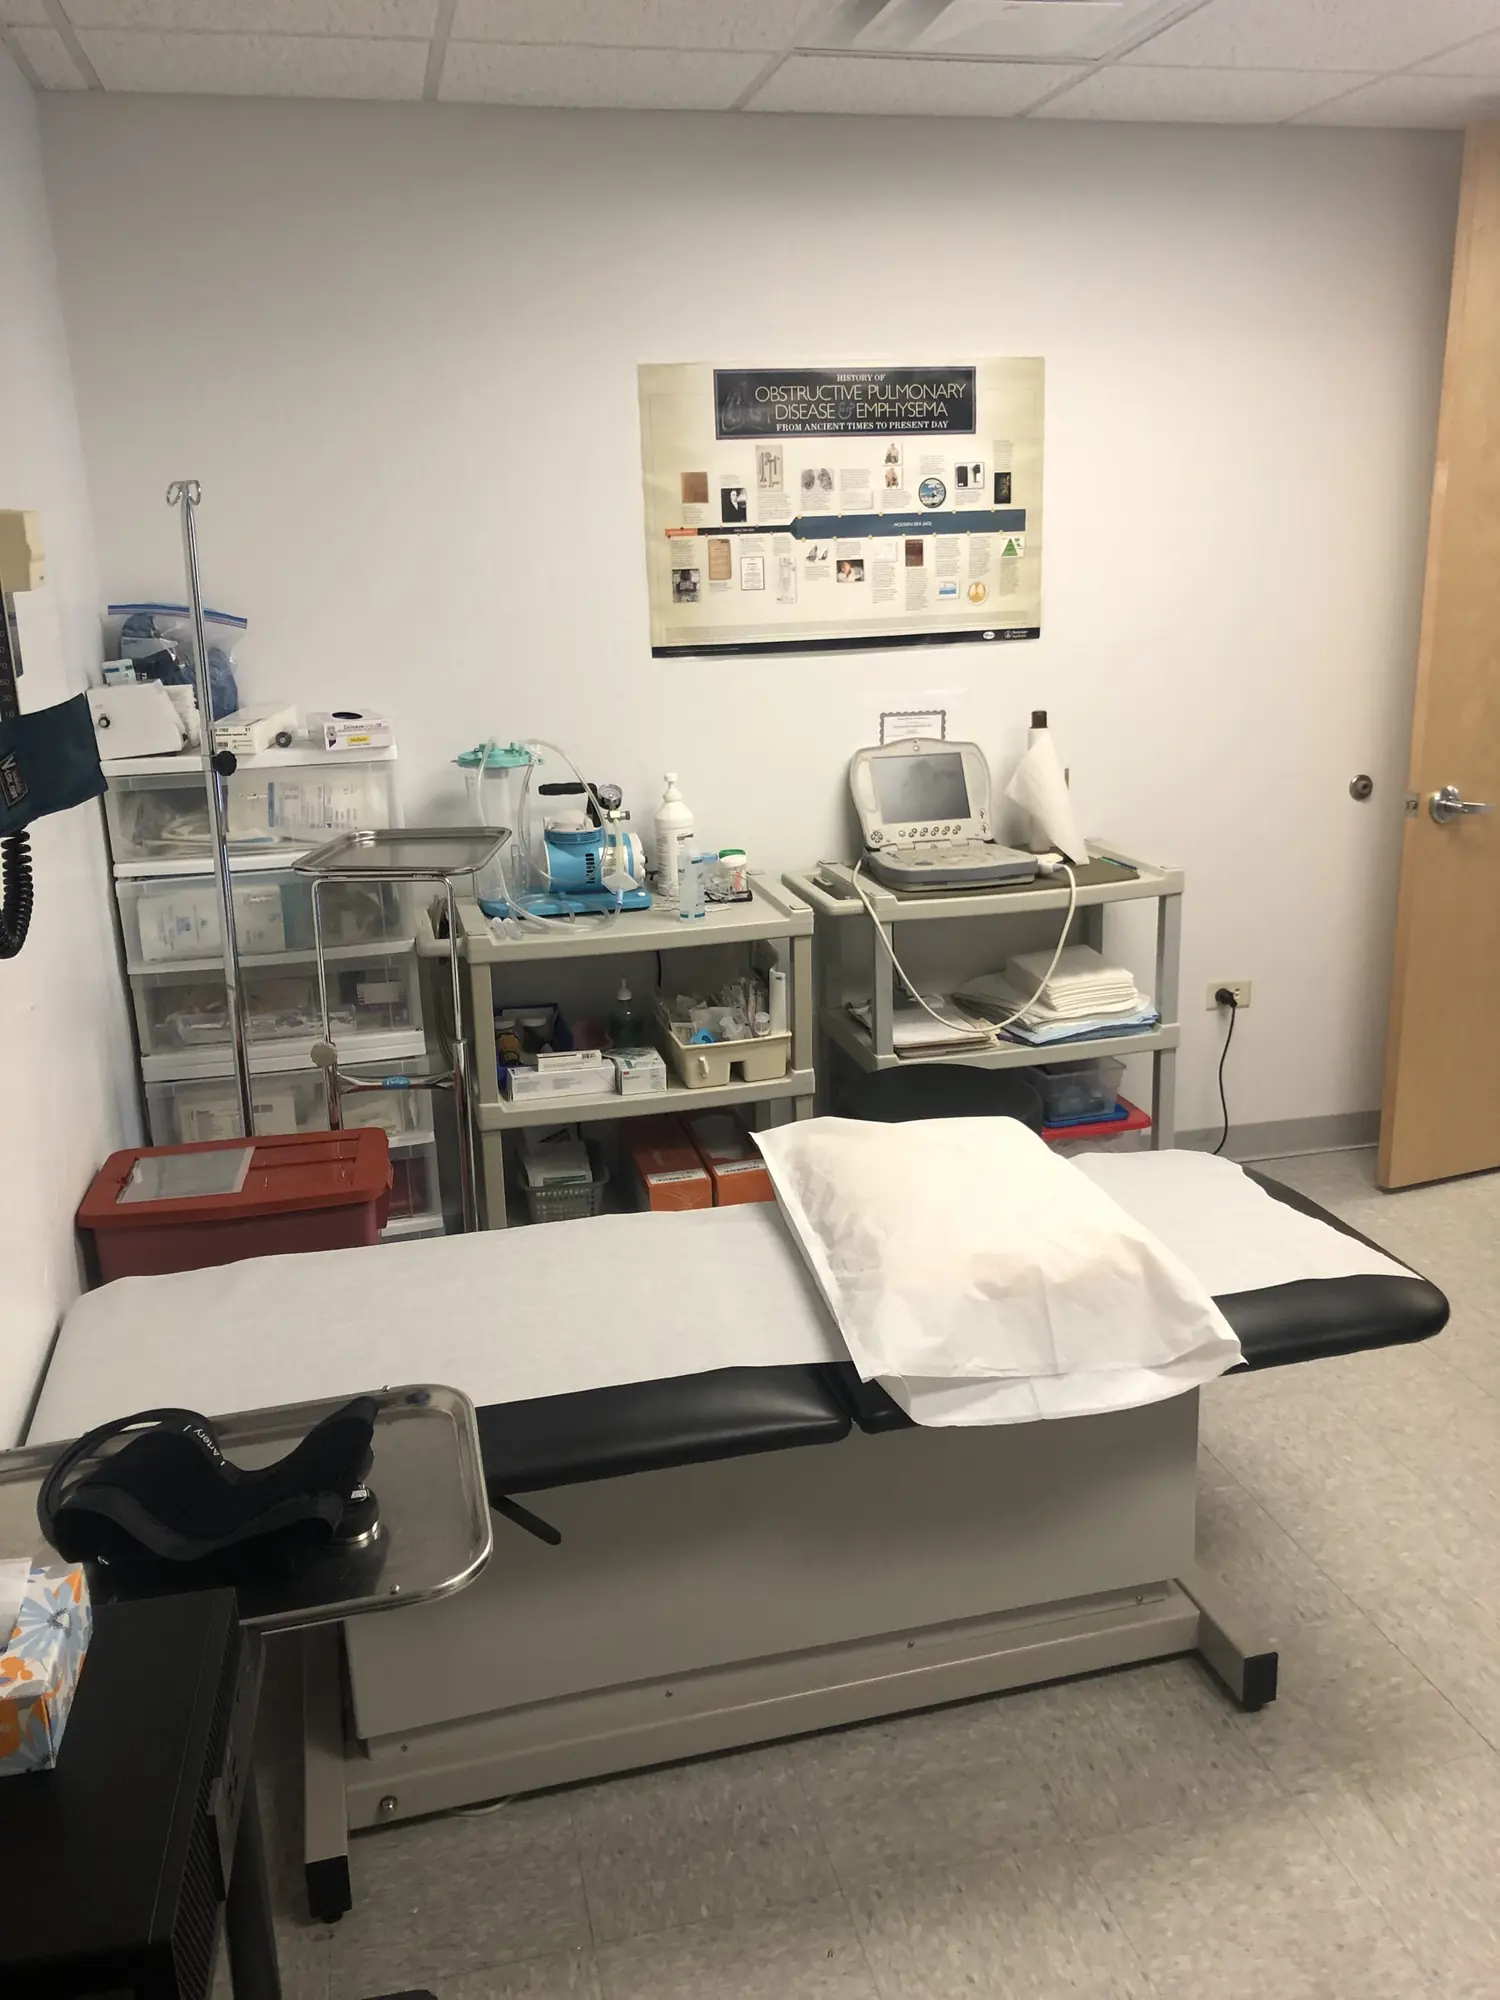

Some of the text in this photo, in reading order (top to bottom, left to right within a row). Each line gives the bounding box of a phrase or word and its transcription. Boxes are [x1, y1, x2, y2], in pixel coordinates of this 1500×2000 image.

[837, 374, 872, 382] HISTORY
[755, 383, 966, 402] OBSTRUCTIVE PULMONARY
[775, 403, 836, 420] DISEASE
[856, 402, 949, 418] EMPHYSEMA
[776, 423, 802, 431] FROM
[804, 422, 845, 430] ANCIENT
[847, 422, 873, 430] TIMES
[889, 420, 930, 429] PRESENT
[931, 420, 949, 428] DAY
[193, 1428, 220, 1455] Artery
